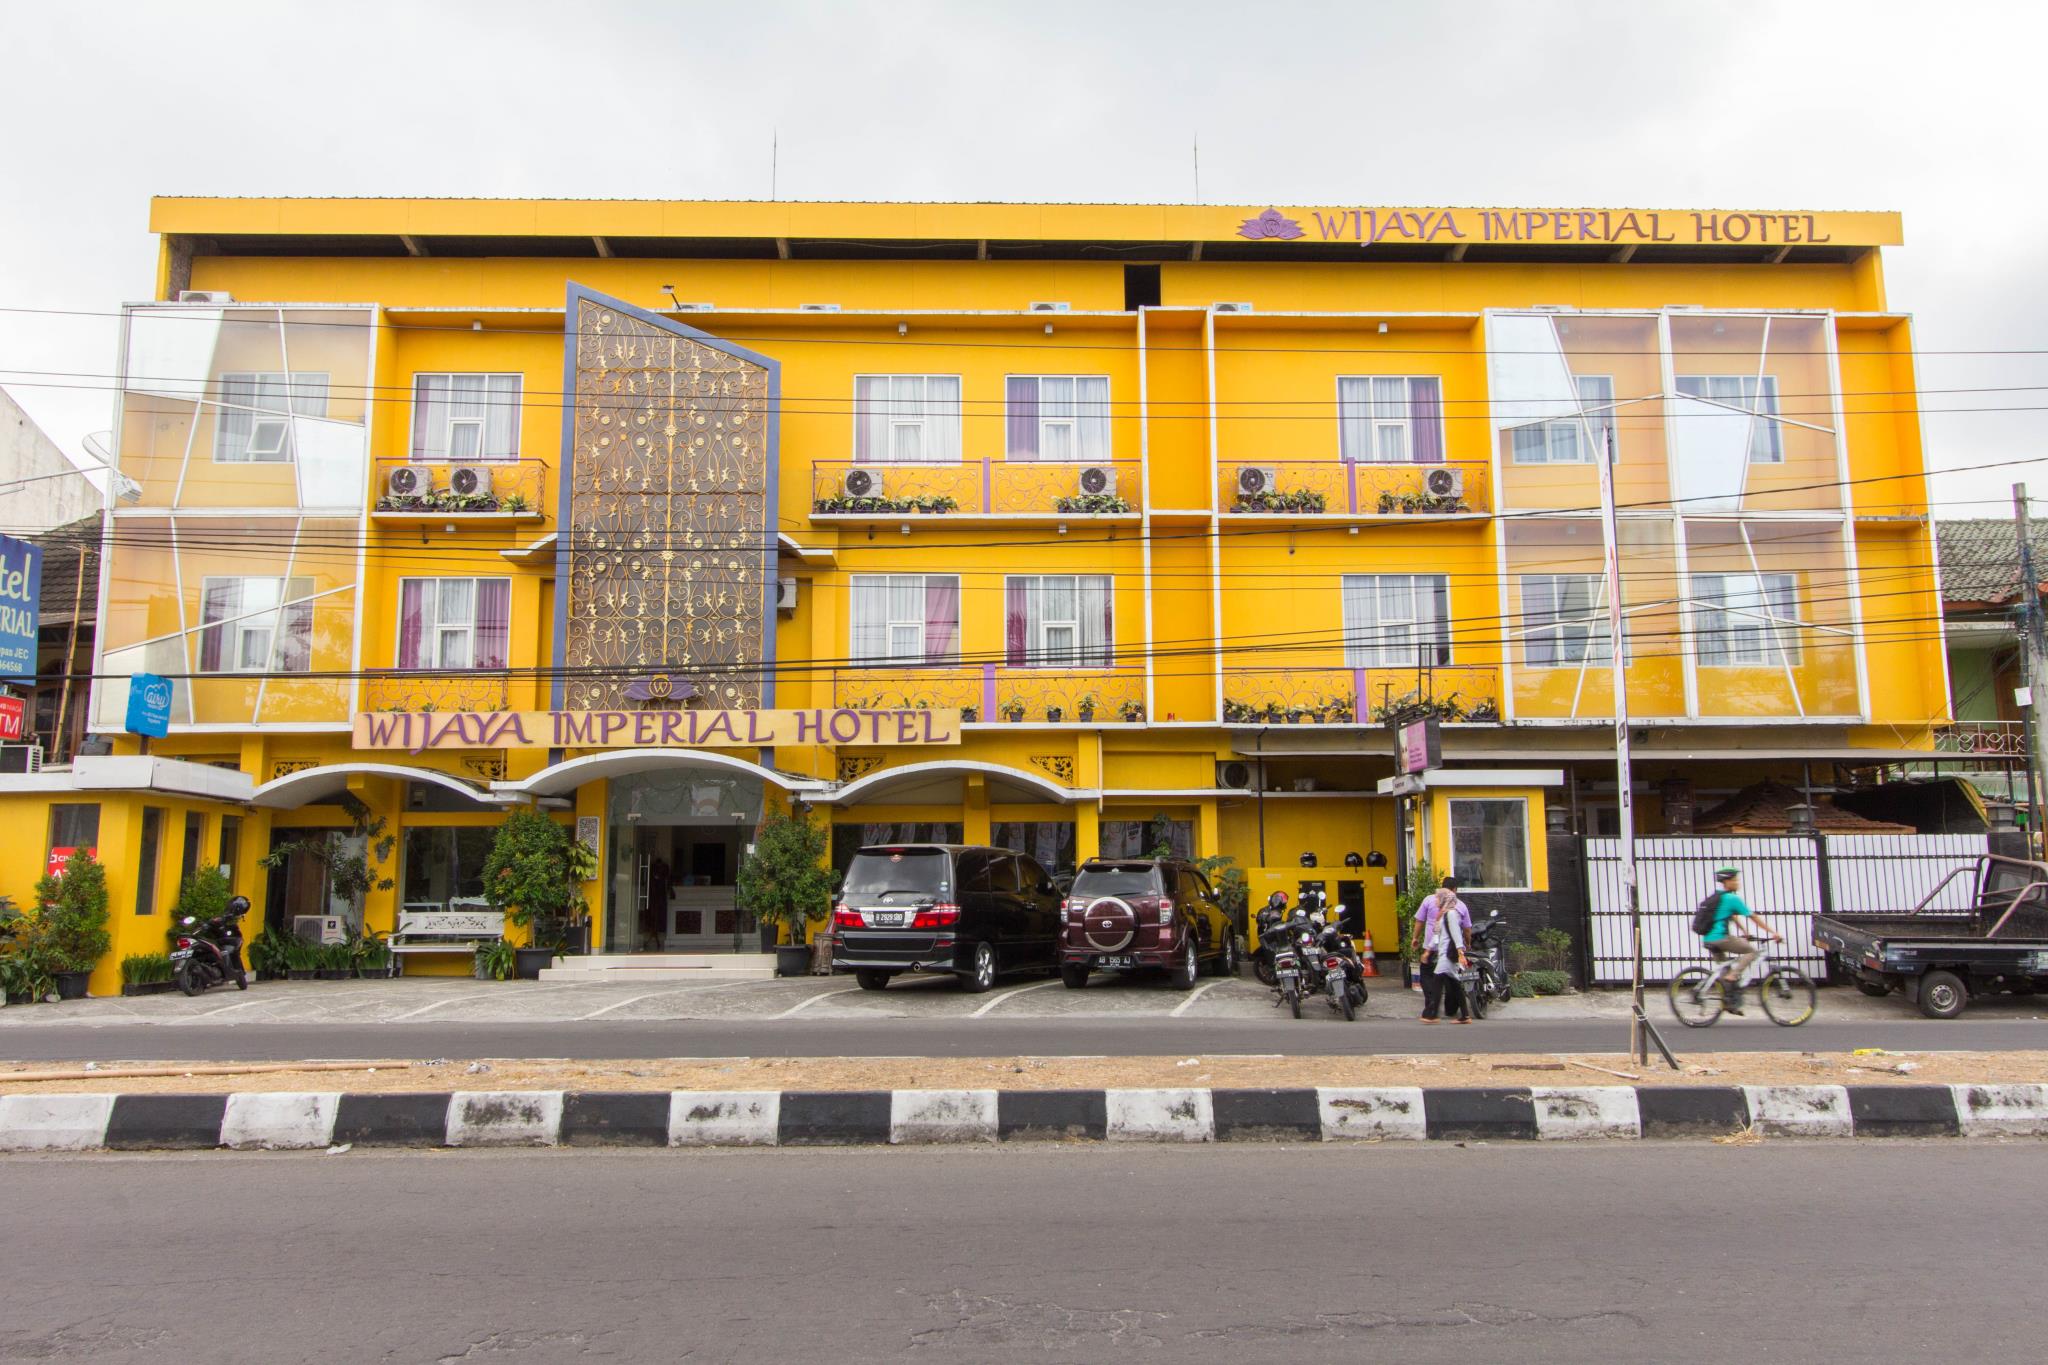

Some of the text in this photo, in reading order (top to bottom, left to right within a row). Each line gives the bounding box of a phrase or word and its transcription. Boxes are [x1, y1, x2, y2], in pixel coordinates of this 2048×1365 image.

[1312, 210, 1831, 247] WIJAYA IMPERIAL HOTEL
[364, 709, 950, 755] WIJAYA IMPERIAL HOTEL
